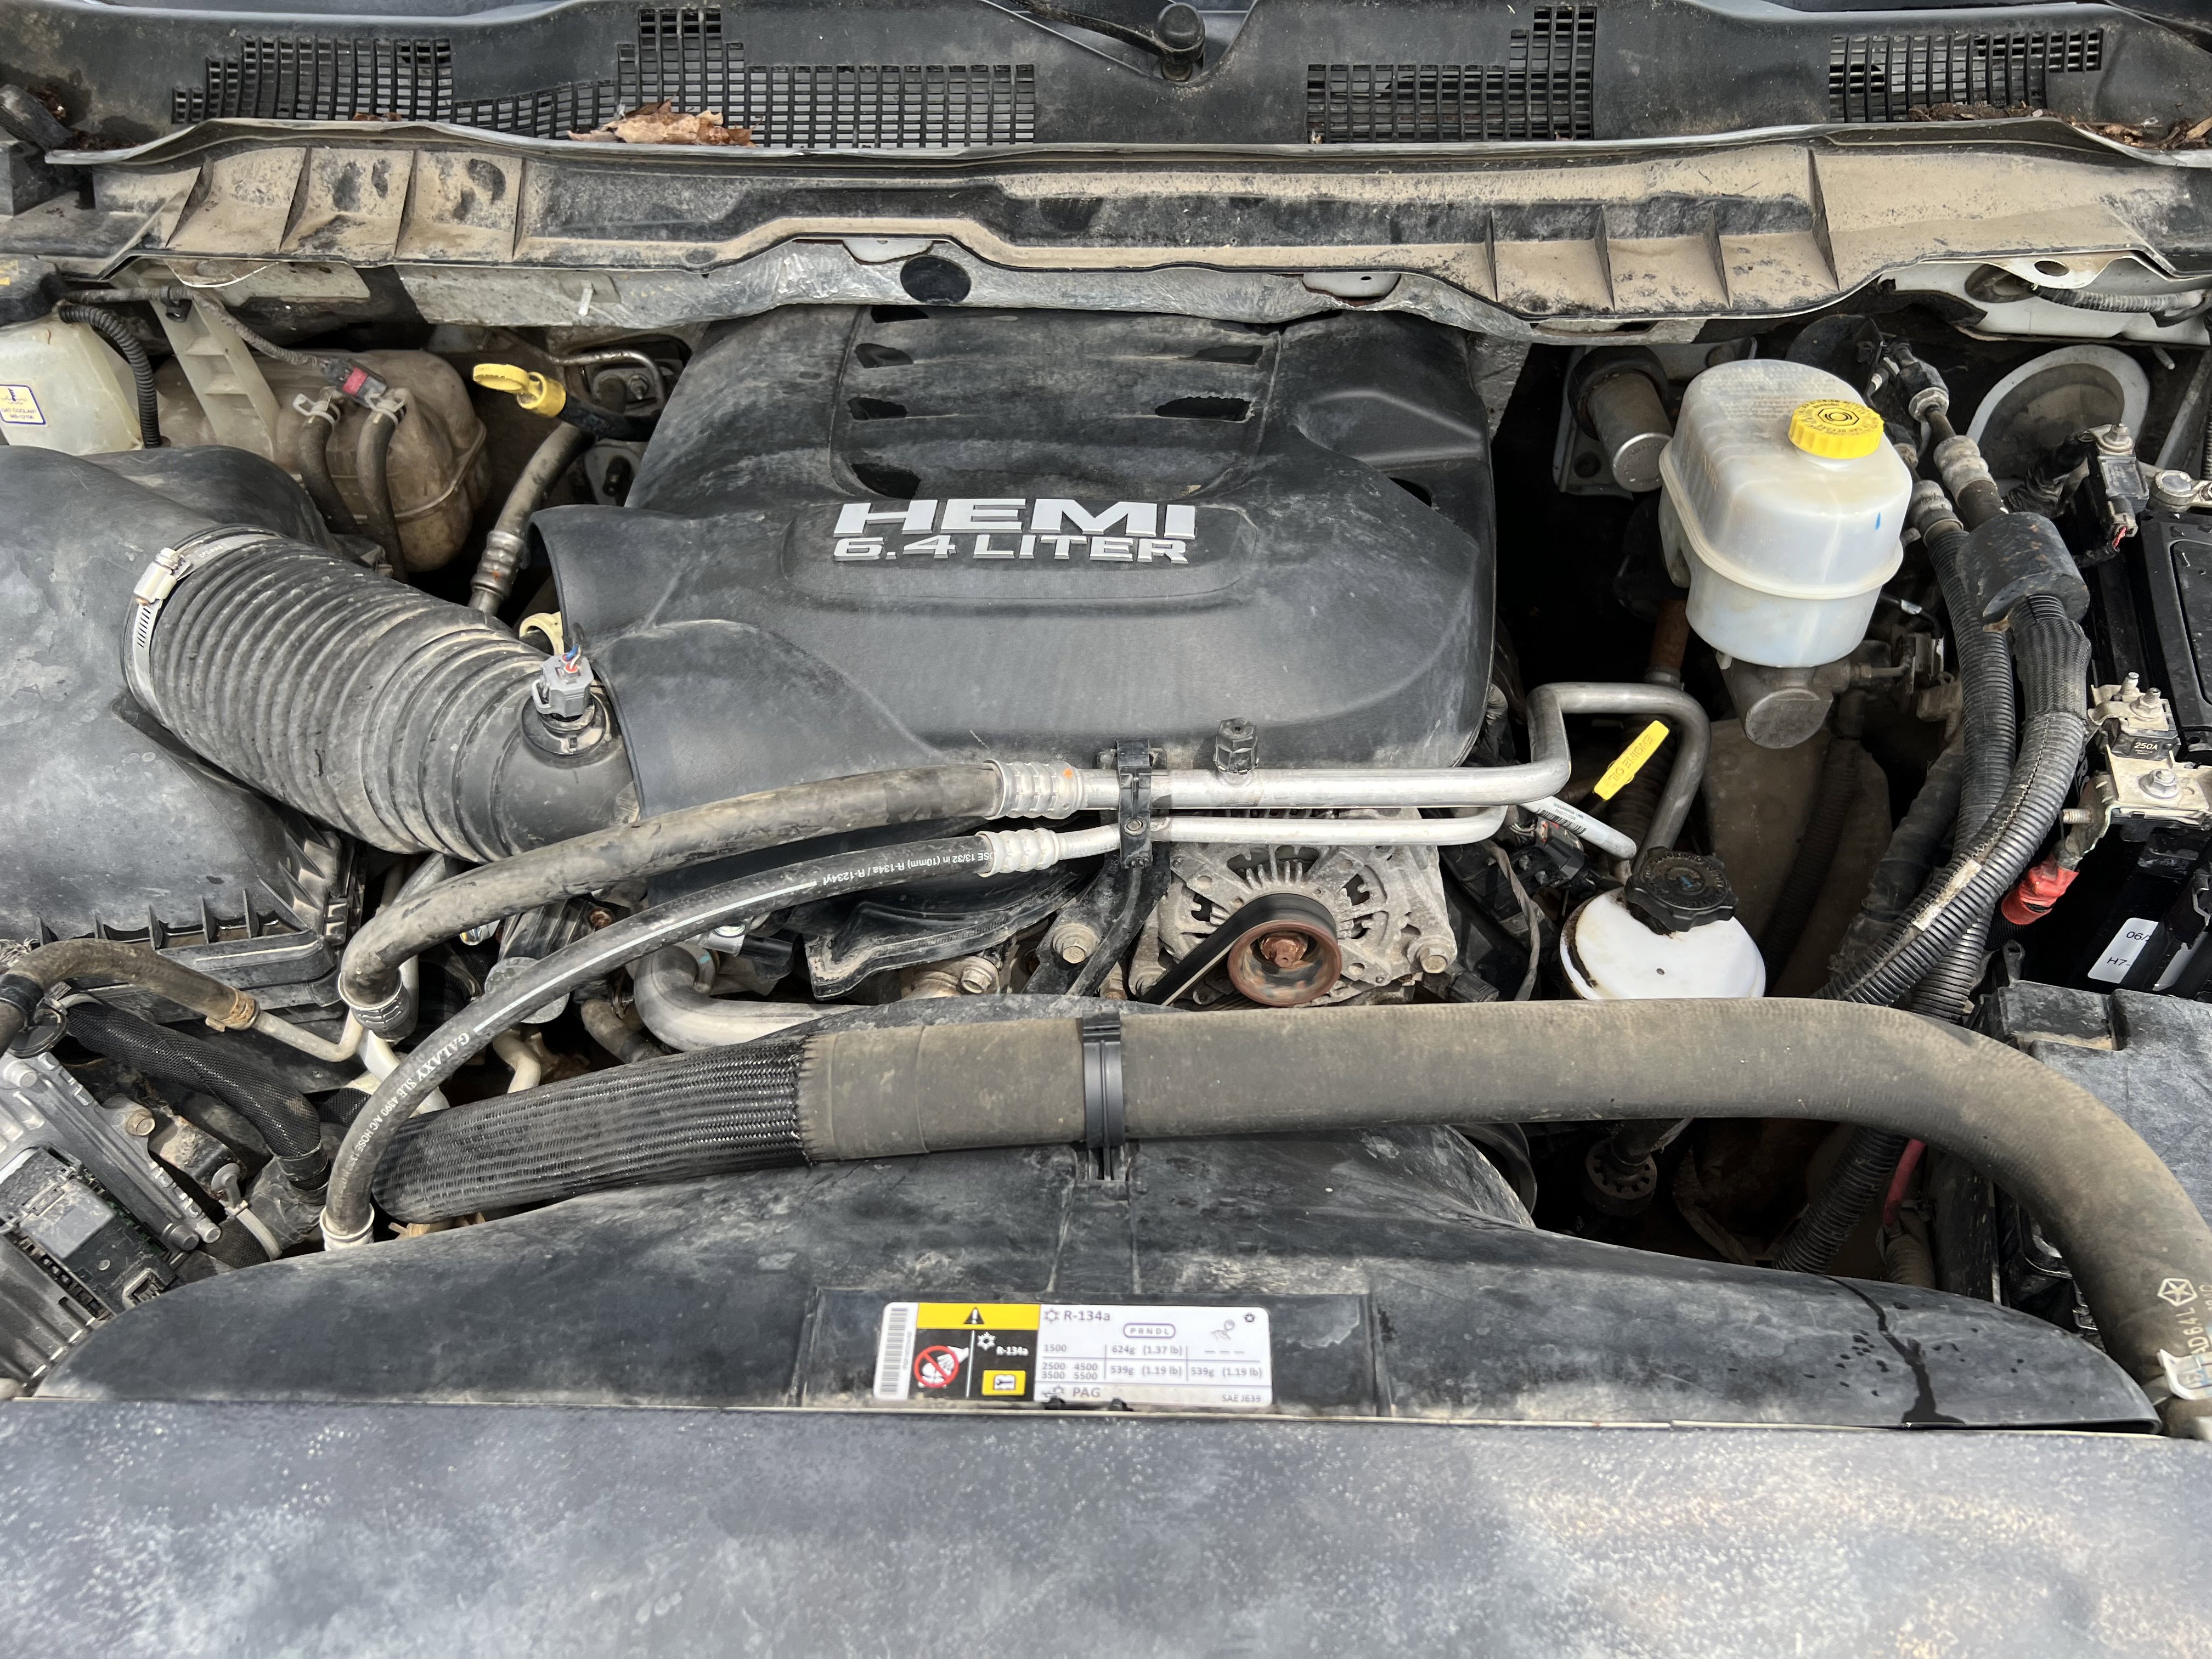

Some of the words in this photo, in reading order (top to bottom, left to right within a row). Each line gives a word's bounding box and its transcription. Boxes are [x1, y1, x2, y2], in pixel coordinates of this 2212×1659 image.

[834, 498, 1196, 539] HEMI
[833, 536, 956, 561] 6.4
[973, 534, 1189, 563] LITER
[1622, 734, 1653, 768] ENGINE
[1608, 766, 1624, 781] OIL
[907, 856, 940, 869] (10mm)
[952, 853, 975, 864] 13/32
[872, 862, 905, 874] R-134a
[823, 869, 865, 885] R-1234yf
[416, 1033, 470, 1081] GALAXY
[369, 1115, 383, 1130] A/C
[355, 1129, 374, 1152] HOSE
[1064, 1310, 1110, 1321] R-134a
[996, 1346, 1029, 1356] R-134a
[1112, 1345, 1135, 1355] 624g
[1143, 1345, 1167, 1356] (1.37
[1170, 1346, 1182, 1356] lb)
[1111, 1365, 1133, 1375] 539g
[1142, 1365, 1166, 1376] (1.19
[1170, 1366, 1181, 1376] lb)
[1191, 1367, 1214, 1377] 539g
[1223, 1368, 1246, 1378] (1.19
[1250, 1368, 1262, 1378] lb)
[1073, 1387, 1101, 1397] PAG
